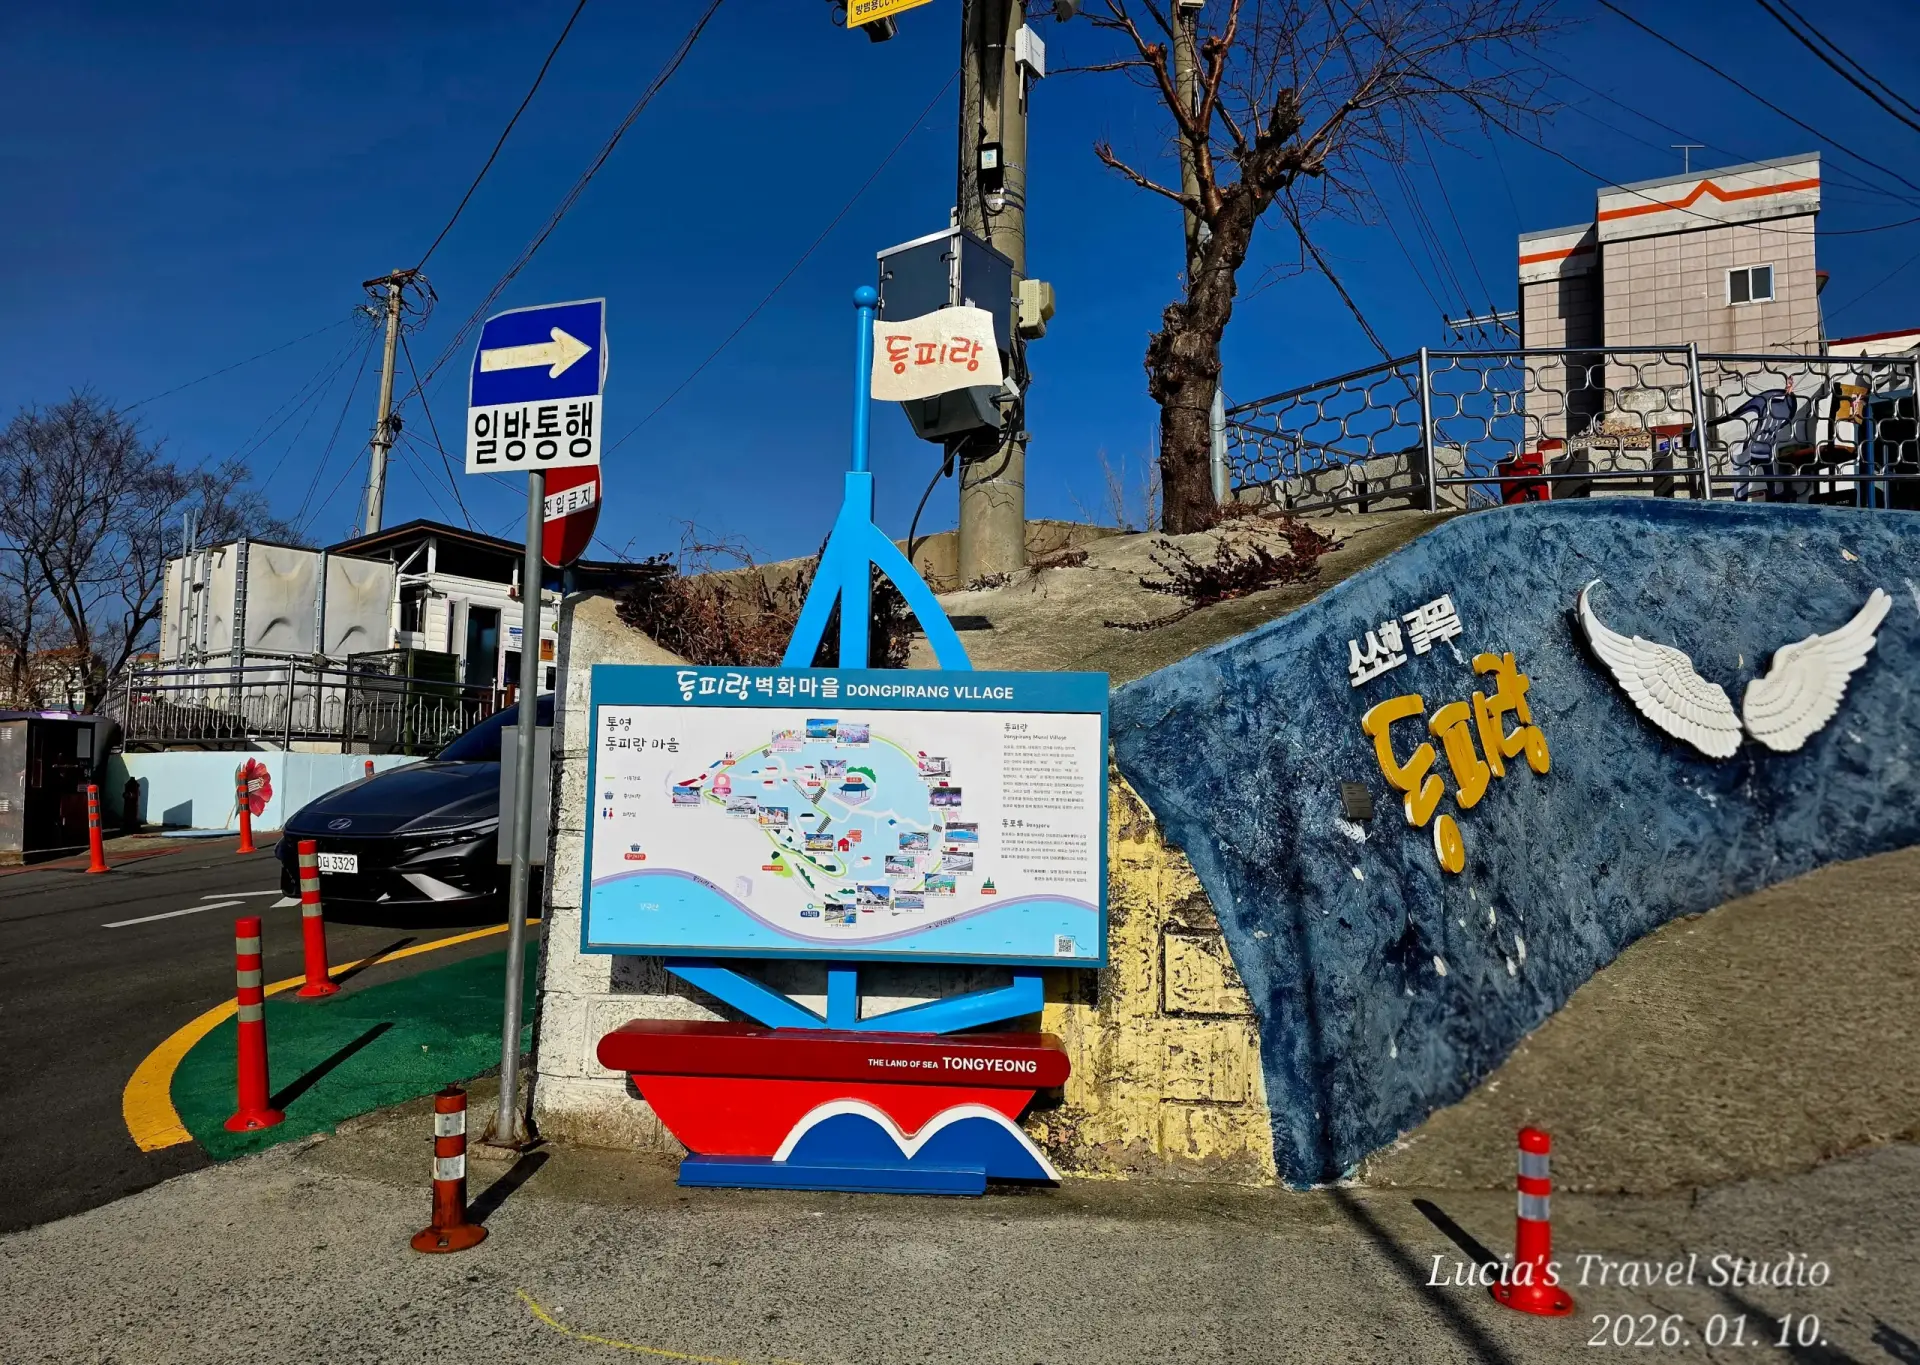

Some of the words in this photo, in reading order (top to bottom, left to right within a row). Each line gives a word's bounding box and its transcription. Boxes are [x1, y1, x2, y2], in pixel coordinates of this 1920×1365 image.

[856, 0, 899, 15] 방범용CC
[885, 335, 983, 374] 동피랑
[474, 401, 593, 465] 일방통행
[544, 486, 591, 517] 진입금지
[1402, 593, 1463, 655] 골목
[676, 670, 752, 701] 동피랑
[755, 676, 840, 698] 벽화마을
[846, 684, 949, 698] DONGPIRANG
[953, 686, 1013, 699] VLLAGE
[606, 716, 631, 731] 통영
[1004, 722, 1028, 732] 동피랑
[605, 736, 647, 752] 동피랑
[652, 737, 680, 752] 마을
[1361, 651, 1550, 874] 동피랑
[332, 857, 355, 870] 3329
[868, 1058, 884, 1066] THE
[885, 1059, 908, 1067] LAND
[910, 1060, 921, 1068] OF
[922, 1061, 939, 1069] SEA
[942, 1057, 1037, 1073] TONGYEONG
